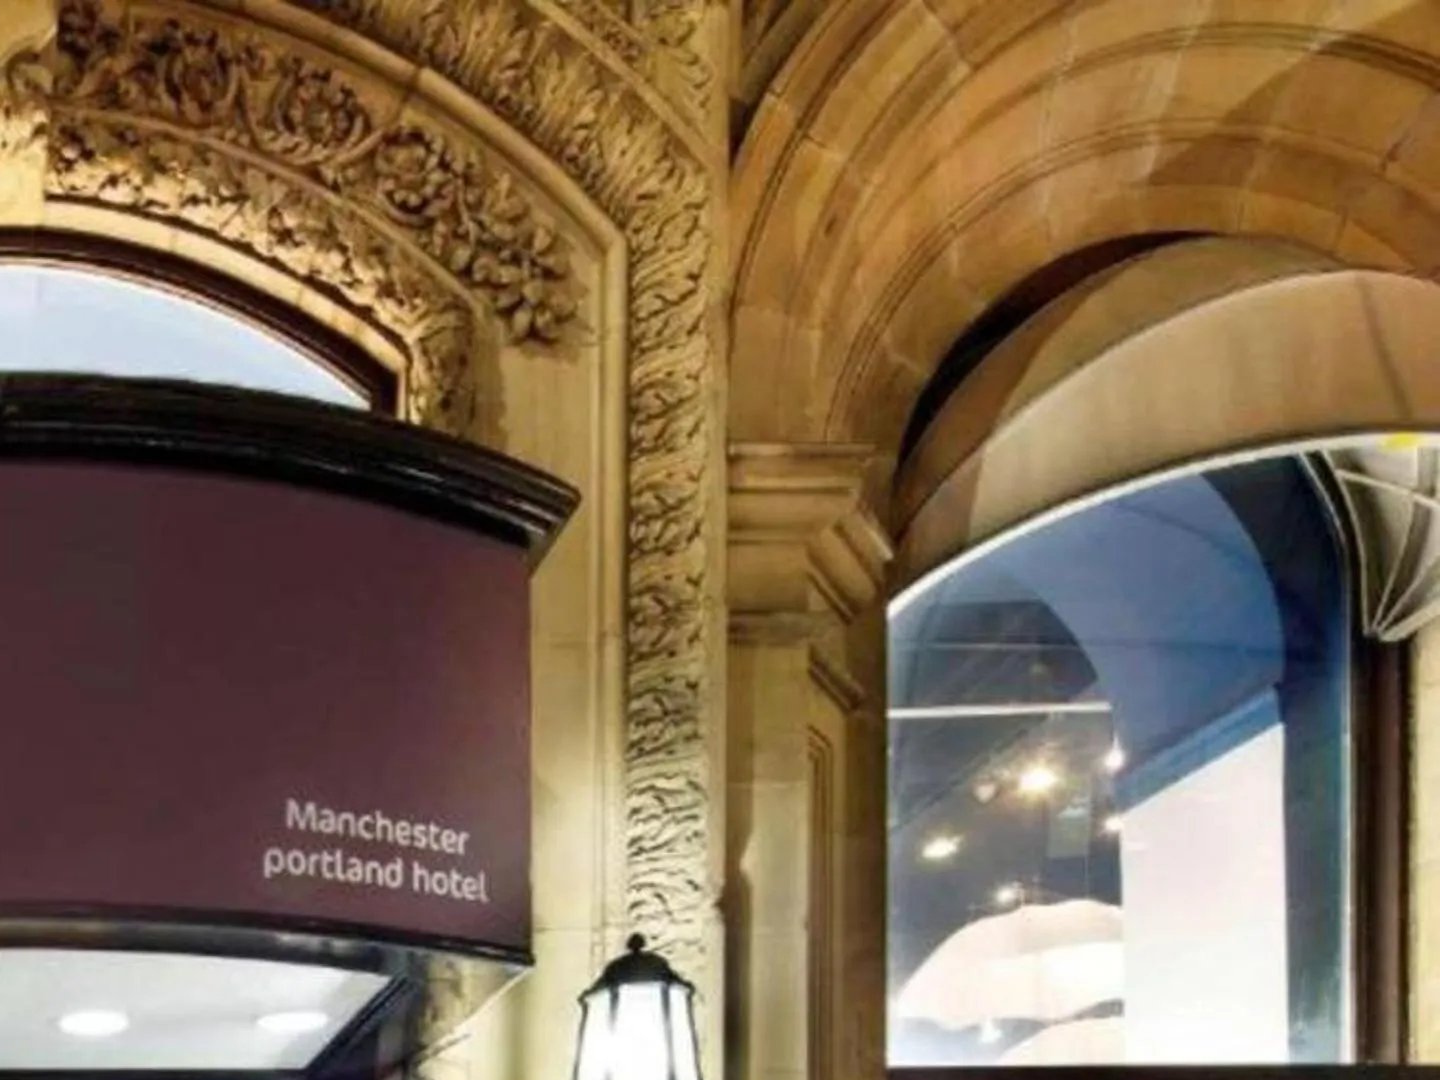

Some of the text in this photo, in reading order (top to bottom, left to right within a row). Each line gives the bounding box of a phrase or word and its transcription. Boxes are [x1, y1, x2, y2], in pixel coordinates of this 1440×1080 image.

[285, 797, 471, 855] Manchester
[263, 847, 491, 904] portland hotel
